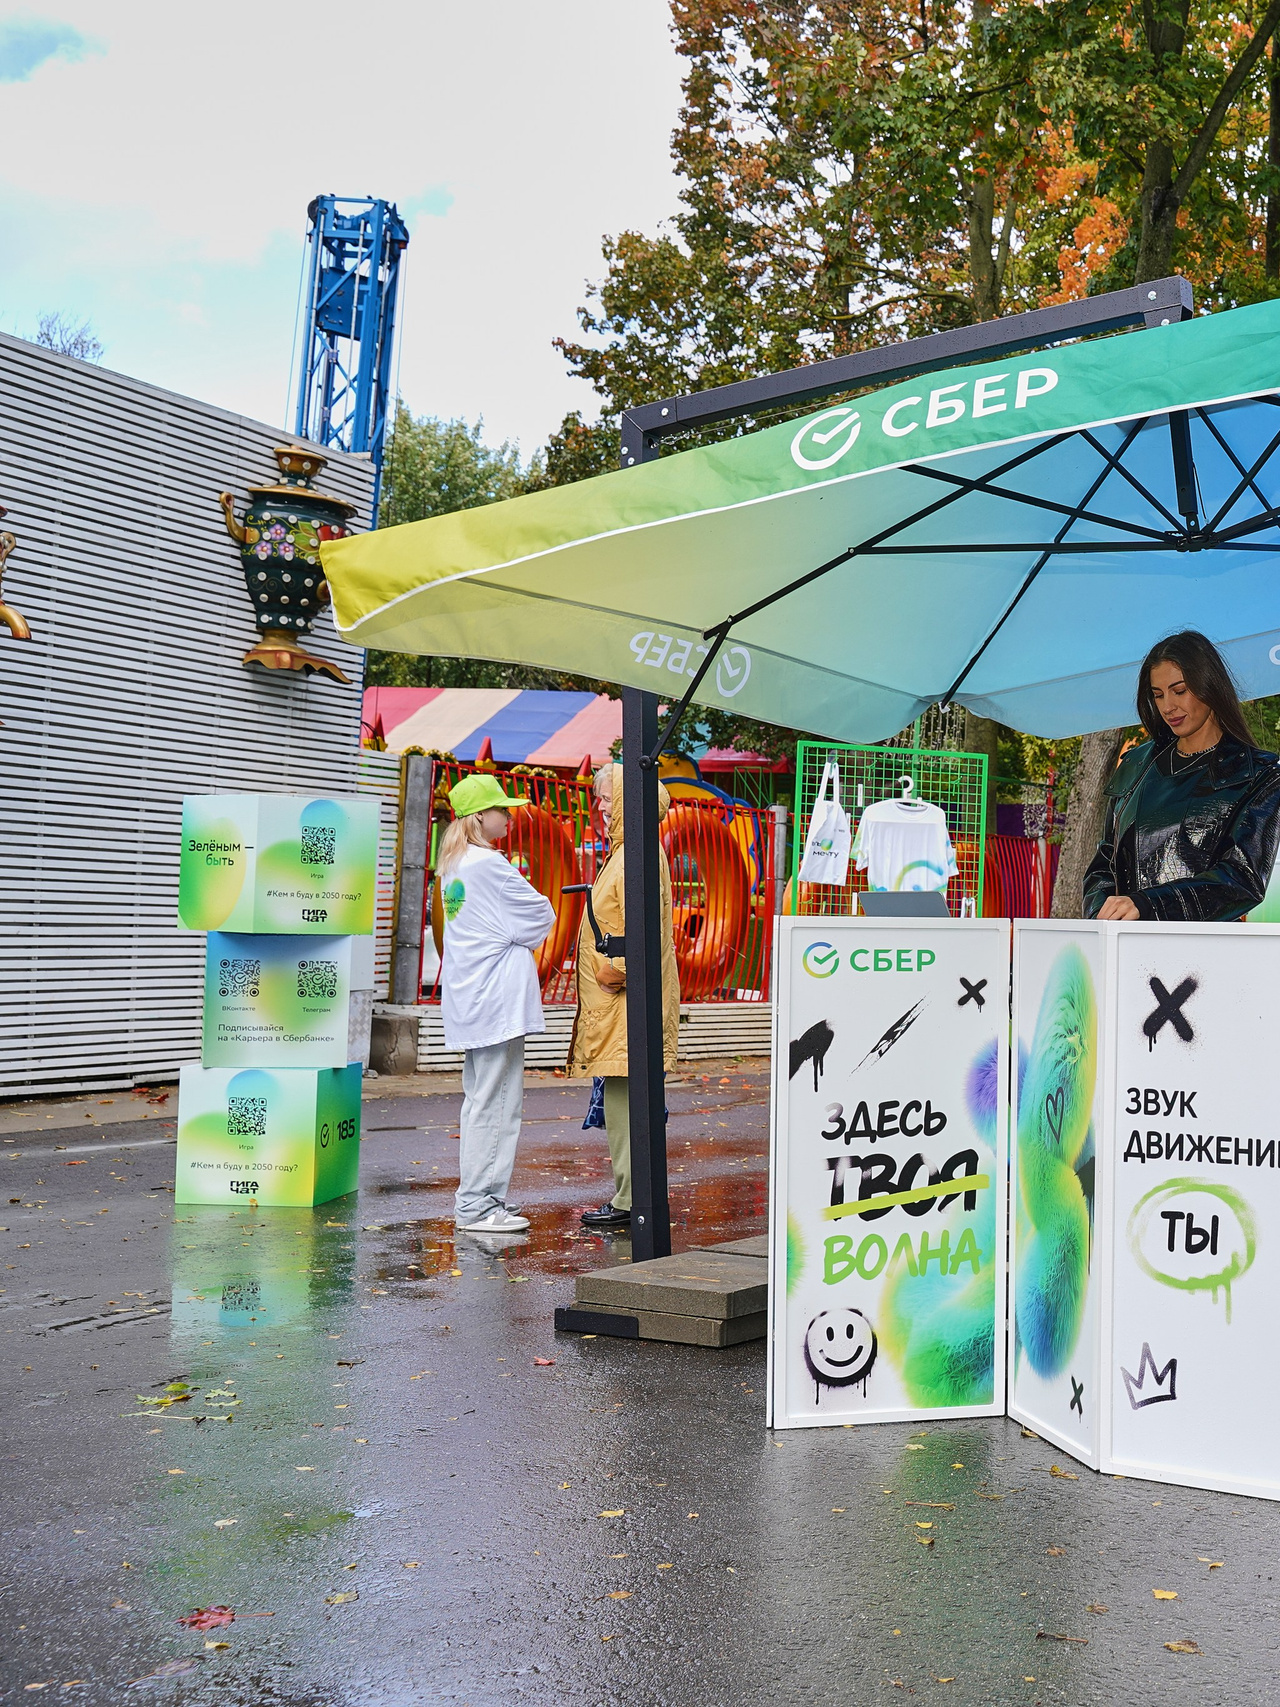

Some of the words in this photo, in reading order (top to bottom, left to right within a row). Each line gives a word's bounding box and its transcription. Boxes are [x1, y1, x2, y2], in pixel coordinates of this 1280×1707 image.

[881, 368, 1059, 437] СБЕР
[188, 839, 241, 852] Зелёным
[205, 853, 234, 866] быть
[310, 872, 324, 880] Игра
[296, 890, 314, 900] буду
[341, 893, 362, 901] году?
[849, 948, 936, 972] СБЕР
[218, 1024, 284, 1032] Подписывайся
[230, 1034, 273, 1043] «Карьера
[282, 1034, 335, 1043] Сбербанке»
[1125, 1087, 1198, 1118] ЗВУК
[337, 1118, 355, 1141] 185
[820, 1099, 947, 1145] ЗДЕСЬ
[223, 1162, 242, 1170] буду
[274, 1164, 298, 1172] году?
[824, 1148, 979, 1221] ТВОЯ
[1160, 1211, 1219, 1256] ТЫ
[822, 1228, 982, 1285] ВОЛНА
